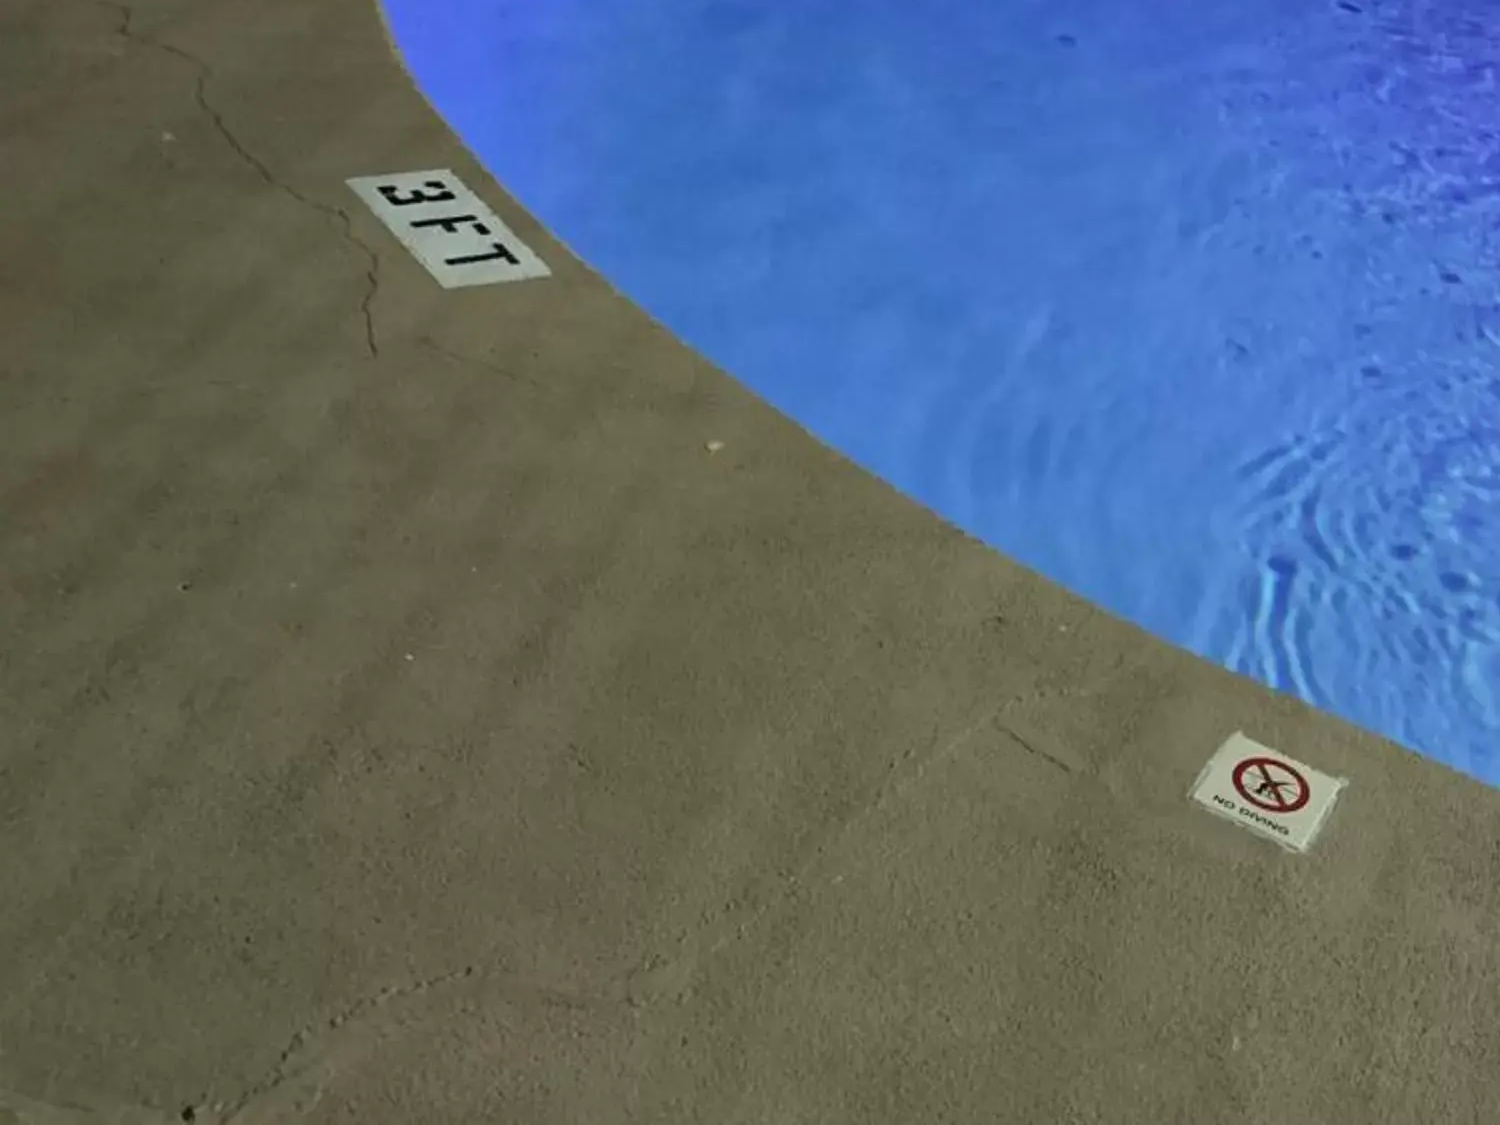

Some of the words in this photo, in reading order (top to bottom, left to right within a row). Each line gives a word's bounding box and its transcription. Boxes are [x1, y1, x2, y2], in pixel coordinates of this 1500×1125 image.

[376, 180, 456, 207] 3
[409, 213, 521, 266] FT
[1212, 793, 1236, 811] NO
[1238, 806, 1291, 837] DIVING
